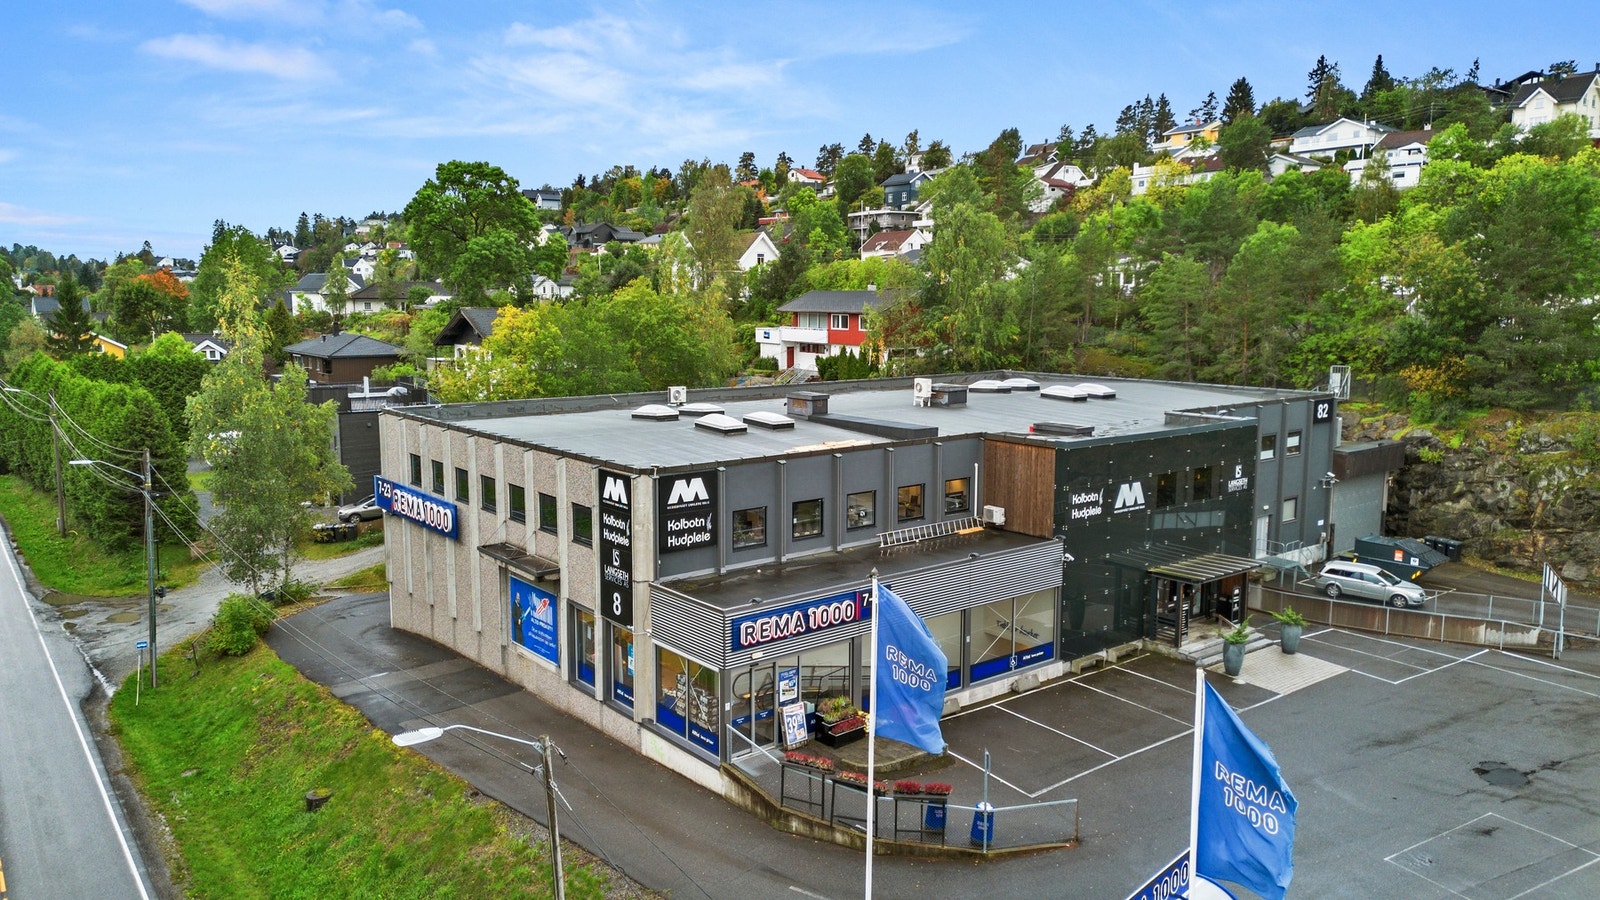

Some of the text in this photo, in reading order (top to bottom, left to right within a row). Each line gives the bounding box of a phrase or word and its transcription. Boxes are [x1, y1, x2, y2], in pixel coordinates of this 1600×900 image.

[1317, 403, 1329, 419] 82
[378, 481, 391, 498] 7-23
[1072, 492, 1099, 505] Kolbotn
[393, 489, 452, 532] REMA 1000
[603, 513, 626, 530] Kolbotn
[1071, 506, 1102, 520] Hudpleie
[667, 518, 705, 532] Kolbotn
[667, 532, 711, 548] Hudpleie
[613, 592, 622, 616] 8
[740, 611, 806, 646] REMA
[807, 600, 855, 630] 1000
[886, 644, 938, 683] REMA
[892, 664, 931, 692] 1000
[1215, 760, 1287, 814] REMA
[1223, 786, 1279, 835] 1000
[1152, 861, 1190, 900] 1000
